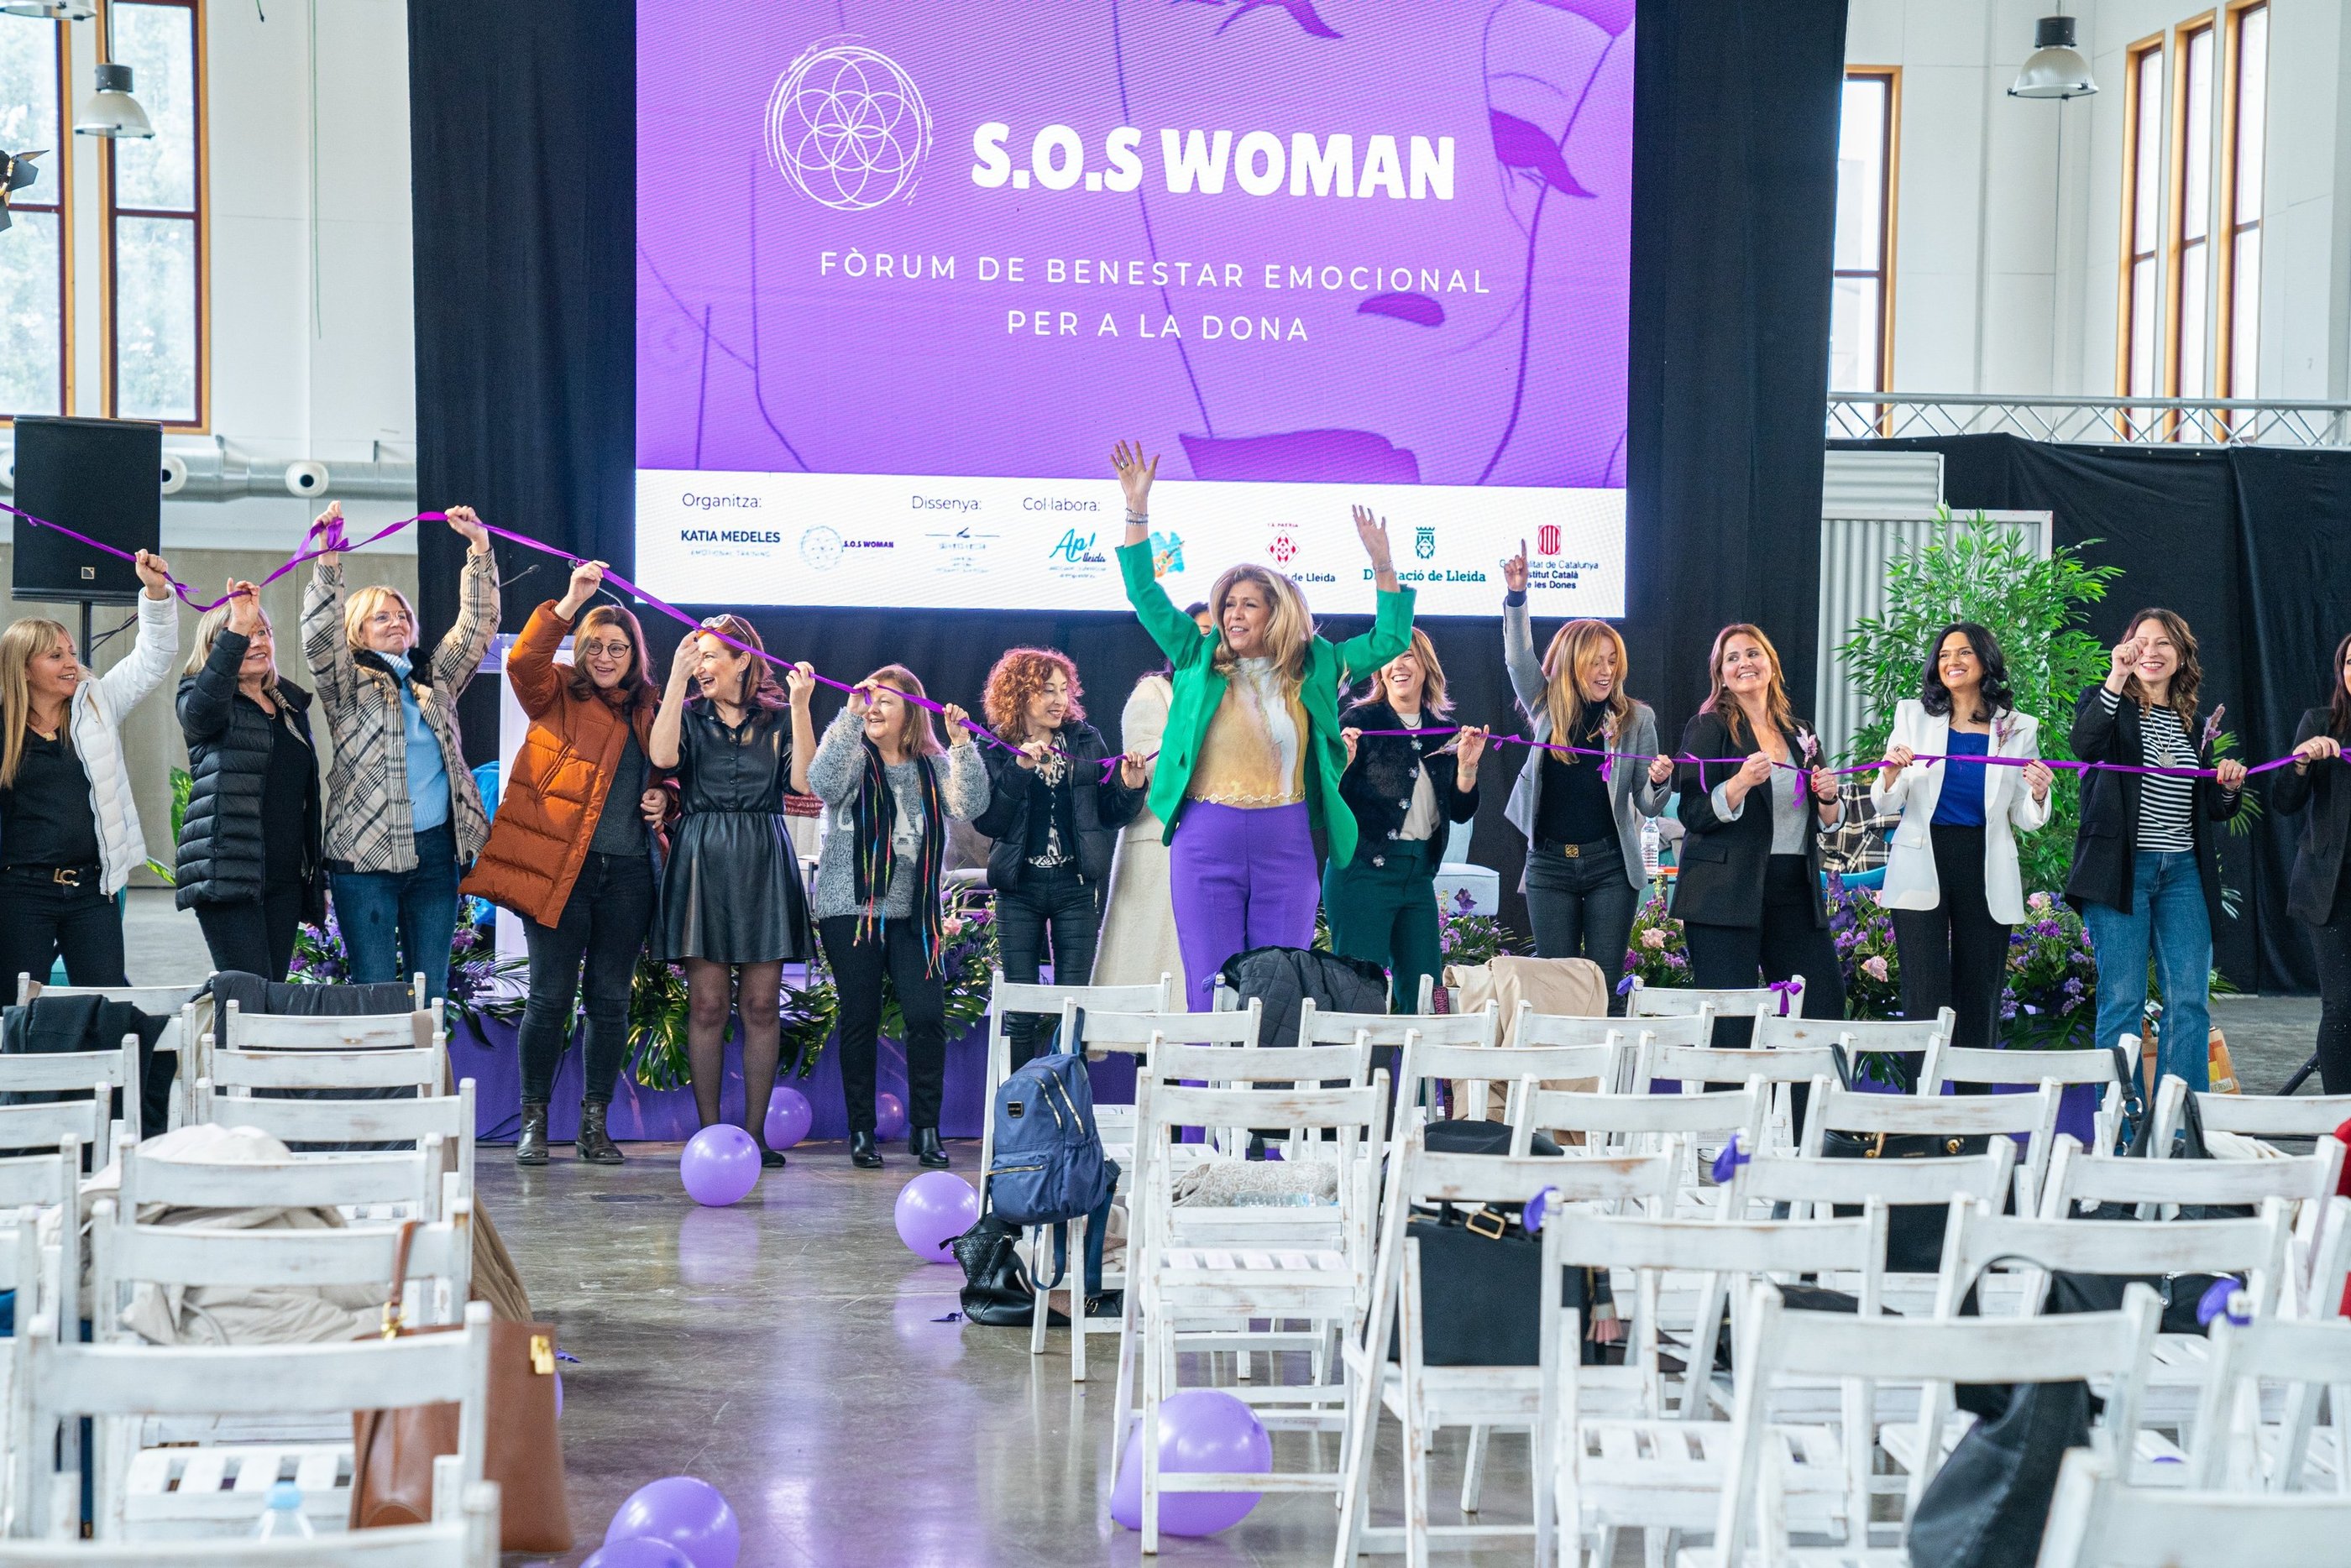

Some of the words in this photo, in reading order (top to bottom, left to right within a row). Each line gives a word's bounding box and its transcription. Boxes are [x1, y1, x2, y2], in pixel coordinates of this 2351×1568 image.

[971, 122, 1144, 192] S.O.S
[1160, 128, 1455, 200] WOMAN
[821, 247, 955, 280] FÒRUM
[978, 256, 1024, 282] DE
[1047, 259, 1243, 287] BENESTAR
[1265, 264, 1490, 294] EMOCIONAL
[1008, 310, 1077, 336] PER
[1097, 312, 1118, 337] A
[1140, 314, 1181, 338] LA
[1202, 315, 1308, 342] DONA
[682, 493, 762, 510] Organitza:
[912, 495, 982, 513] Dissenya:
[681, 529, 718, 542] KATIA
[721, 531, 781, 543] MEDELES
[863, 541, 894, 549] WOMAN
[1546, 560, 1557, 568] de
[1558, 560, 1599, 571] Catalunya
[1291, 572, 1303, 582] de
[1306, 572, 1336, 583] Lleida
[1364, 569, 1425, 581] Dació
[1428, 571, 1443, 581] de
[1446, 571, 1486, 582] Lleida
[1527, 571, 1549, 579] stitut
[1552, 570, 1579, 579] Català
[1549, 581, 1577, 589] Dones
